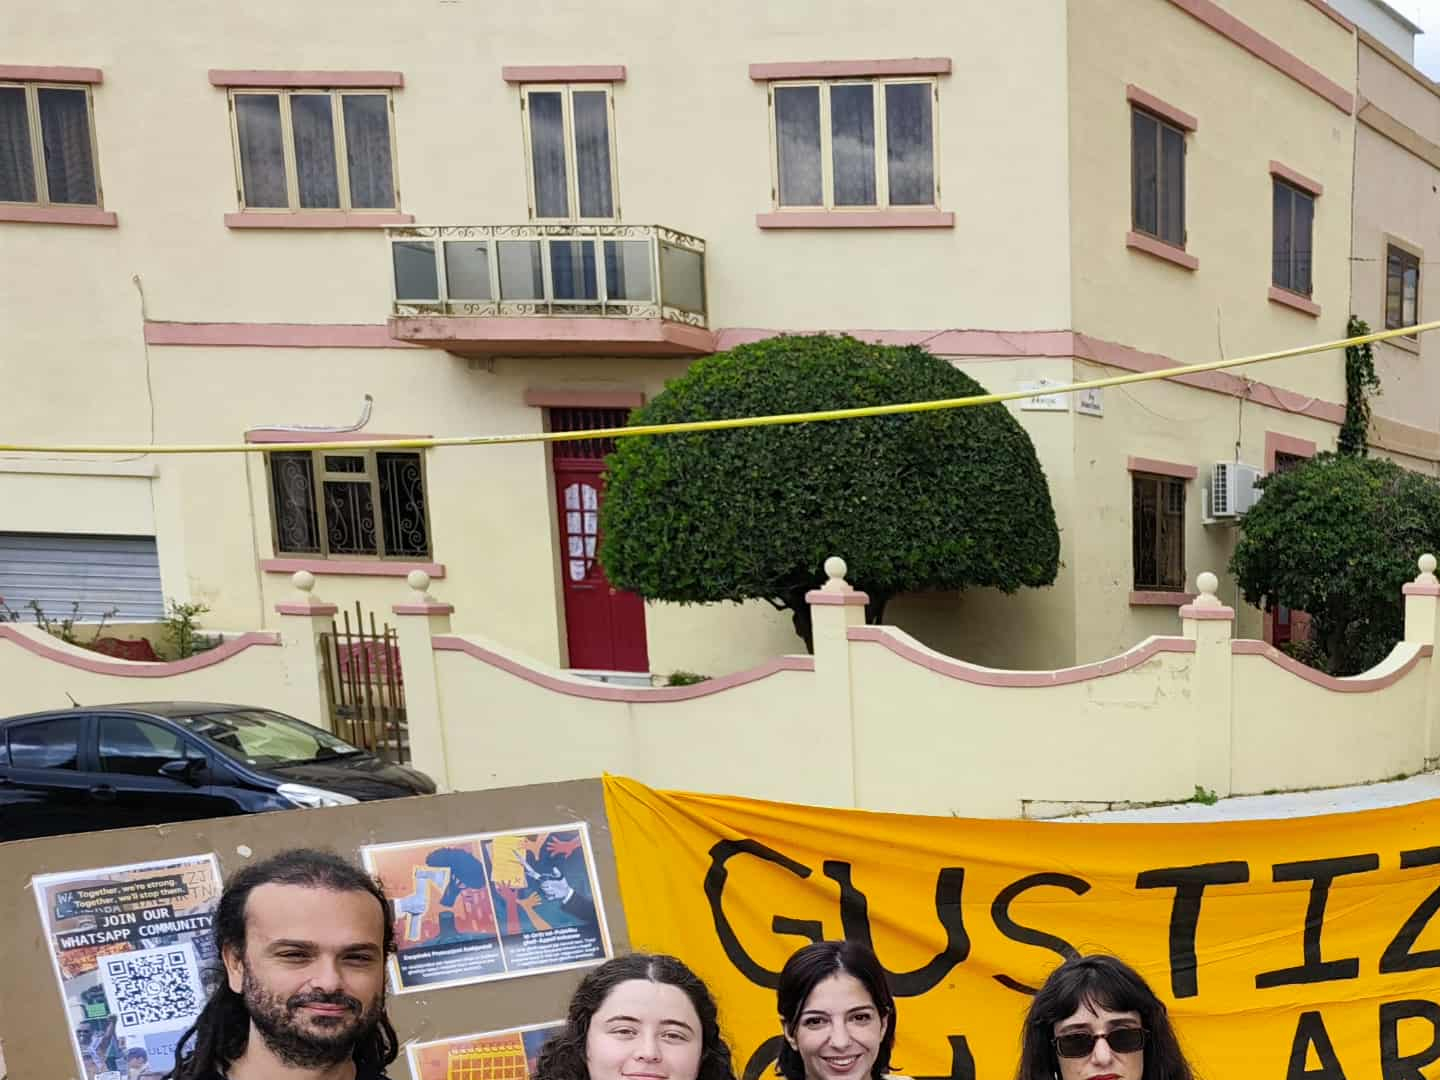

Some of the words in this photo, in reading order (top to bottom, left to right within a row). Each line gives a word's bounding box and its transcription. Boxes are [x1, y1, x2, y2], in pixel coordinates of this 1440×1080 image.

[102, 911, 137, 928] JOIN
[143, 907, 169, 921] OUR
[60, 928, 131, 949] WHATSAPP
[138, 915, 213, 938] COMMUNITY
